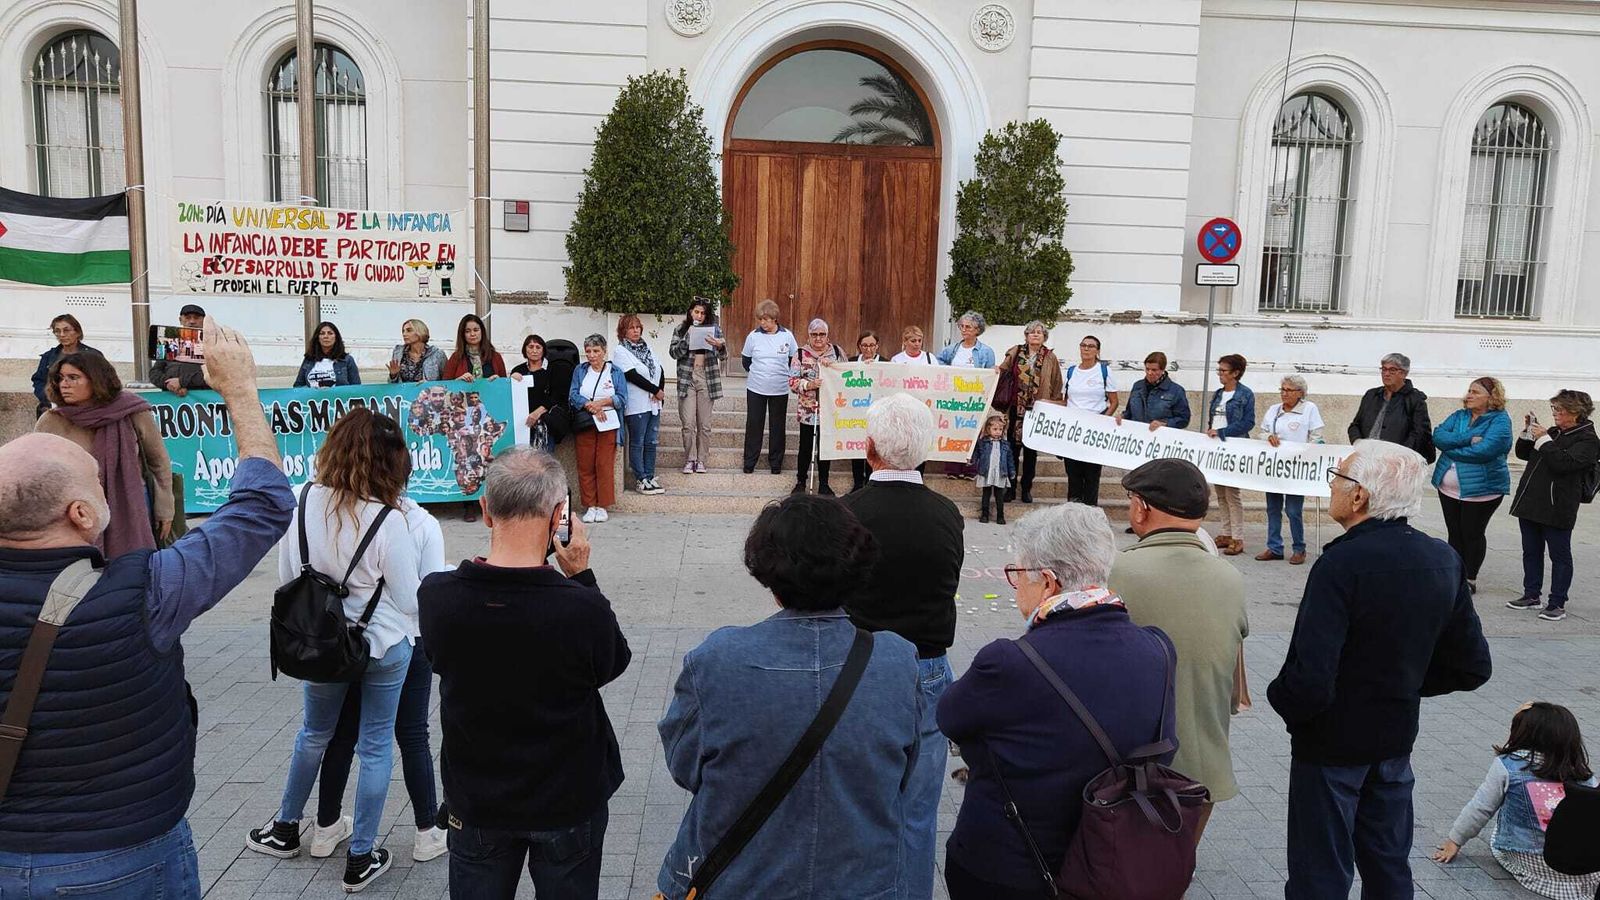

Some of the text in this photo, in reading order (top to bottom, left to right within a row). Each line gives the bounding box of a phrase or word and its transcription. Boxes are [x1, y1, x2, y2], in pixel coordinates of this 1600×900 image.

[207, 201, 226, 225] DÍA
[232, 206, 330, 230] UNIVERSAL
[336, 212, 358, 230] DE
[362, 212, 380, 230] LA
[387, 212, 452, 232] INFANCIA
[183, 232, 456, 261] LA INFANCIA DEBE PARTICIPAR EN
[222, 258, 314, 279] DESARROLLO
[321, 262, 338, 280] DE
[344, 262, 359, 281] TU
[364, 264, 405, 282] CIUDAD
[213, 279, 338, 296] PRODENI EL PUERTO
[902, 376, 928, 390] niños
[835, 392, 847, 408] de
[408, 440, 442, 471] ida
[1067, 420, 1082, 443] de
[1083, 430, 1144, 456] asesinatos
[1145, 436, 1160, 459] de
[1161, 439, 1195, 461] niños
[1196, 449, 1206, 467] y
[1205, 446, 1236, 473] niñas
[1239, 455, 1254, 475] en
[1257, 451, 1323, 482] Palestina!
